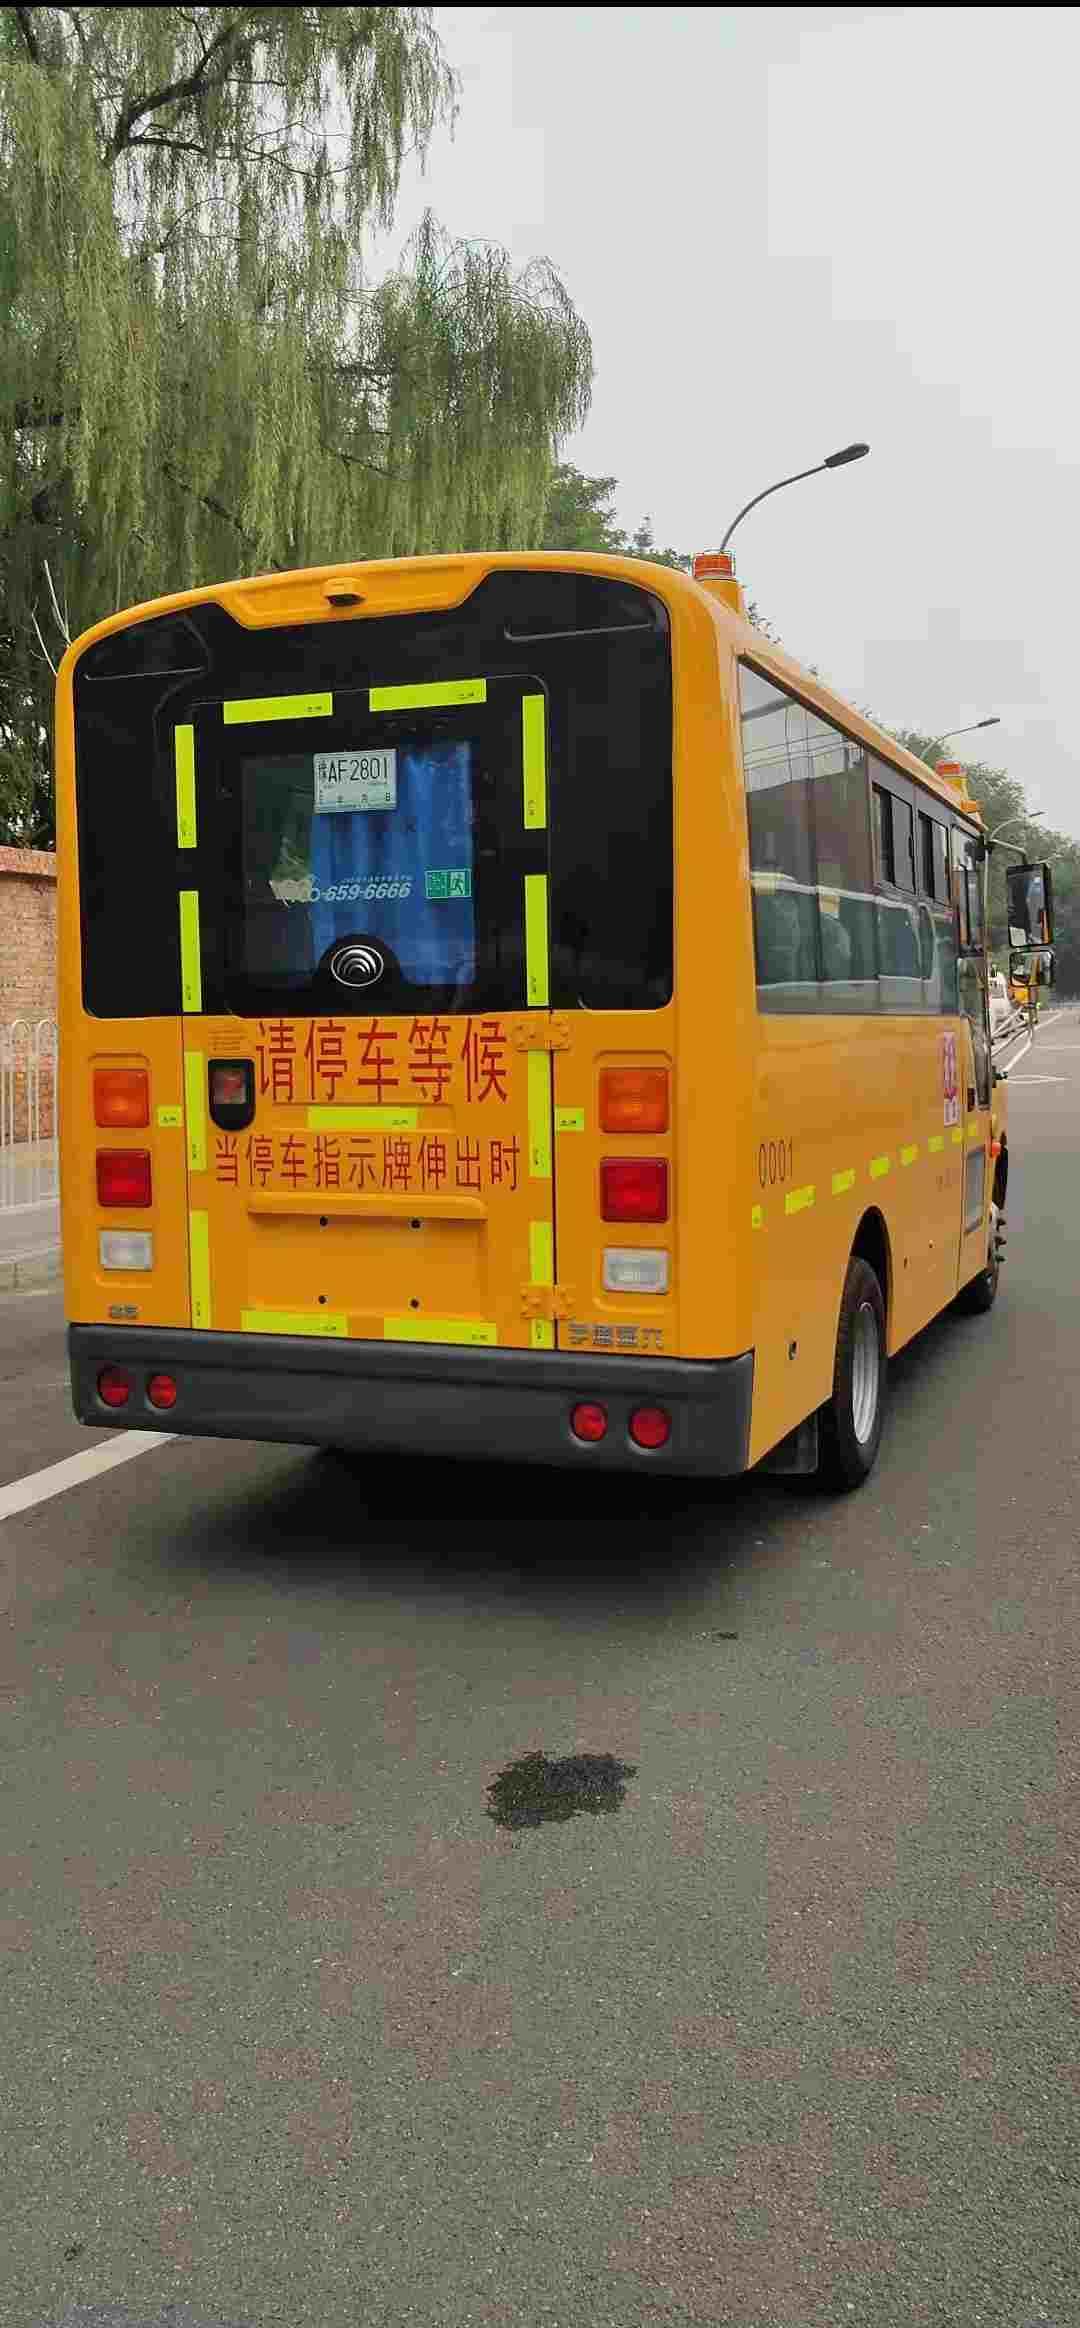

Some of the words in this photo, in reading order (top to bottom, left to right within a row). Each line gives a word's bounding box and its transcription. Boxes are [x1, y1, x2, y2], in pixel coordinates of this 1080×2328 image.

[290, 881, 412, 903] 0-659-6666
[255, 1017, 509, 1104] 请停车等候
[215, 1134, 521, 1192] 当停车指示牌伸出时
[758, 1136, 793, 1190] 0001
